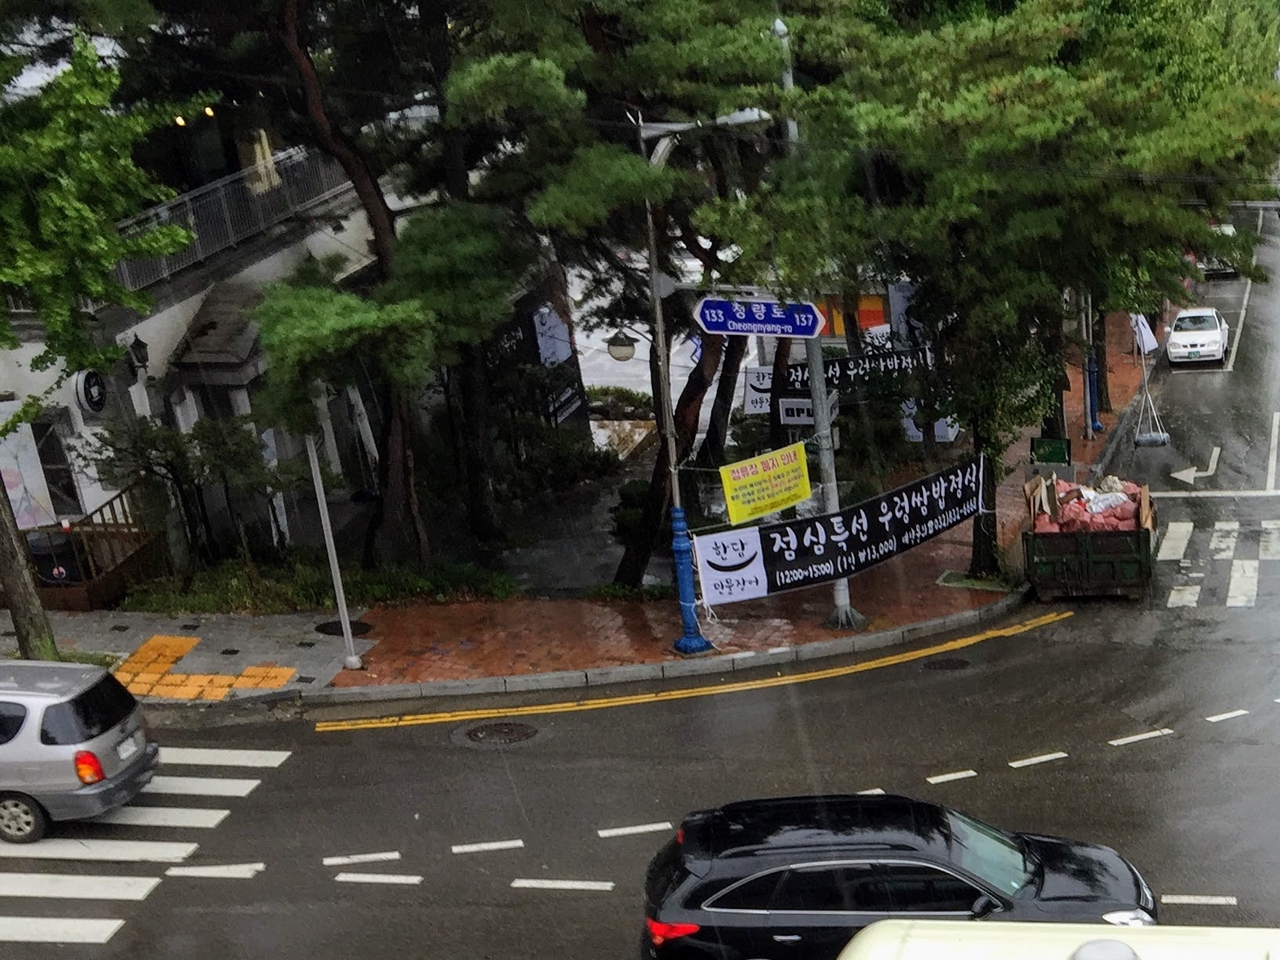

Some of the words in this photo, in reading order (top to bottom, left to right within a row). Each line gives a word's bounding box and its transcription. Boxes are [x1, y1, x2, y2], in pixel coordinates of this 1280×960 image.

[704, 309, 724, 322] 133
[794, 313, 813, 326] 137
[727, 320, 793, 334] Cheongnyang-ro
[770, 509, 869, 562] 점심특선
[878, 462, 977, 532] 우렁쌈밥정식
[776, 559, 835, 587] (12:00~15:00)
